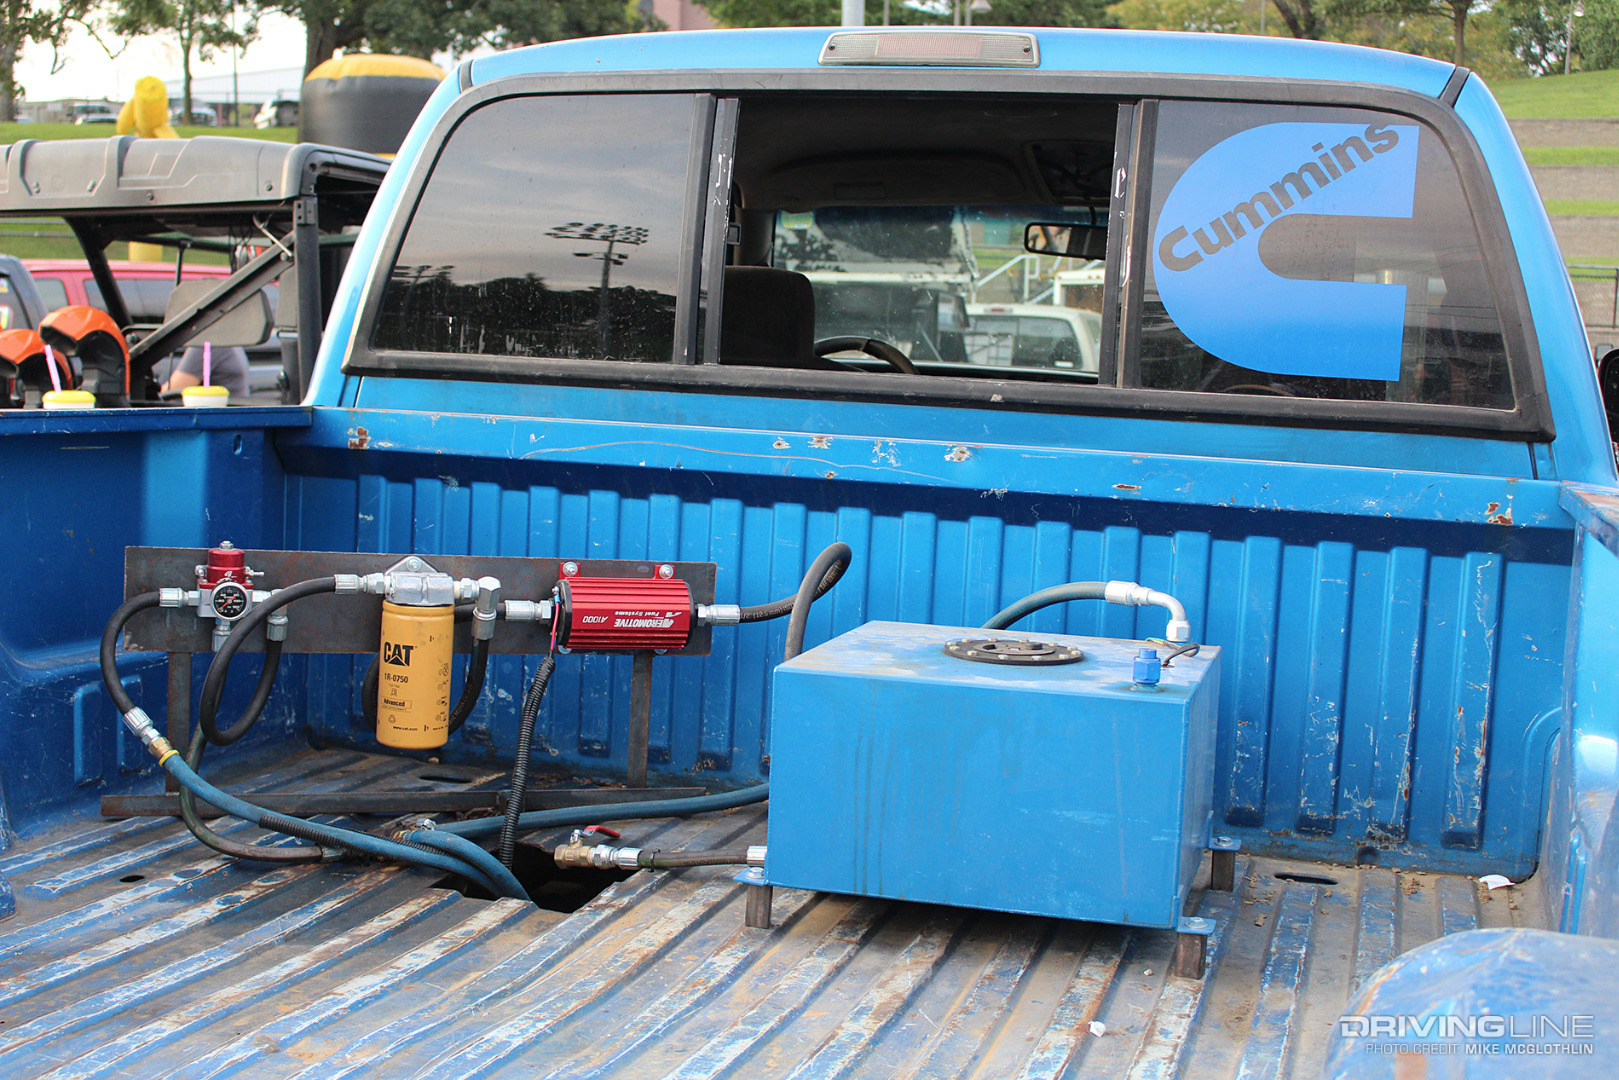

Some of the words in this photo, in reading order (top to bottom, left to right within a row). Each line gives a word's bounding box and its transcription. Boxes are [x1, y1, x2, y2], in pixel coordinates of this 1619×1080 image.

[1159, 123, 1399, 272] Cummins
[384, 641, 414, 667] CAT
[384, 672, 409, 683] 1R-0750
[383, 698, 405, 707] Advanced
